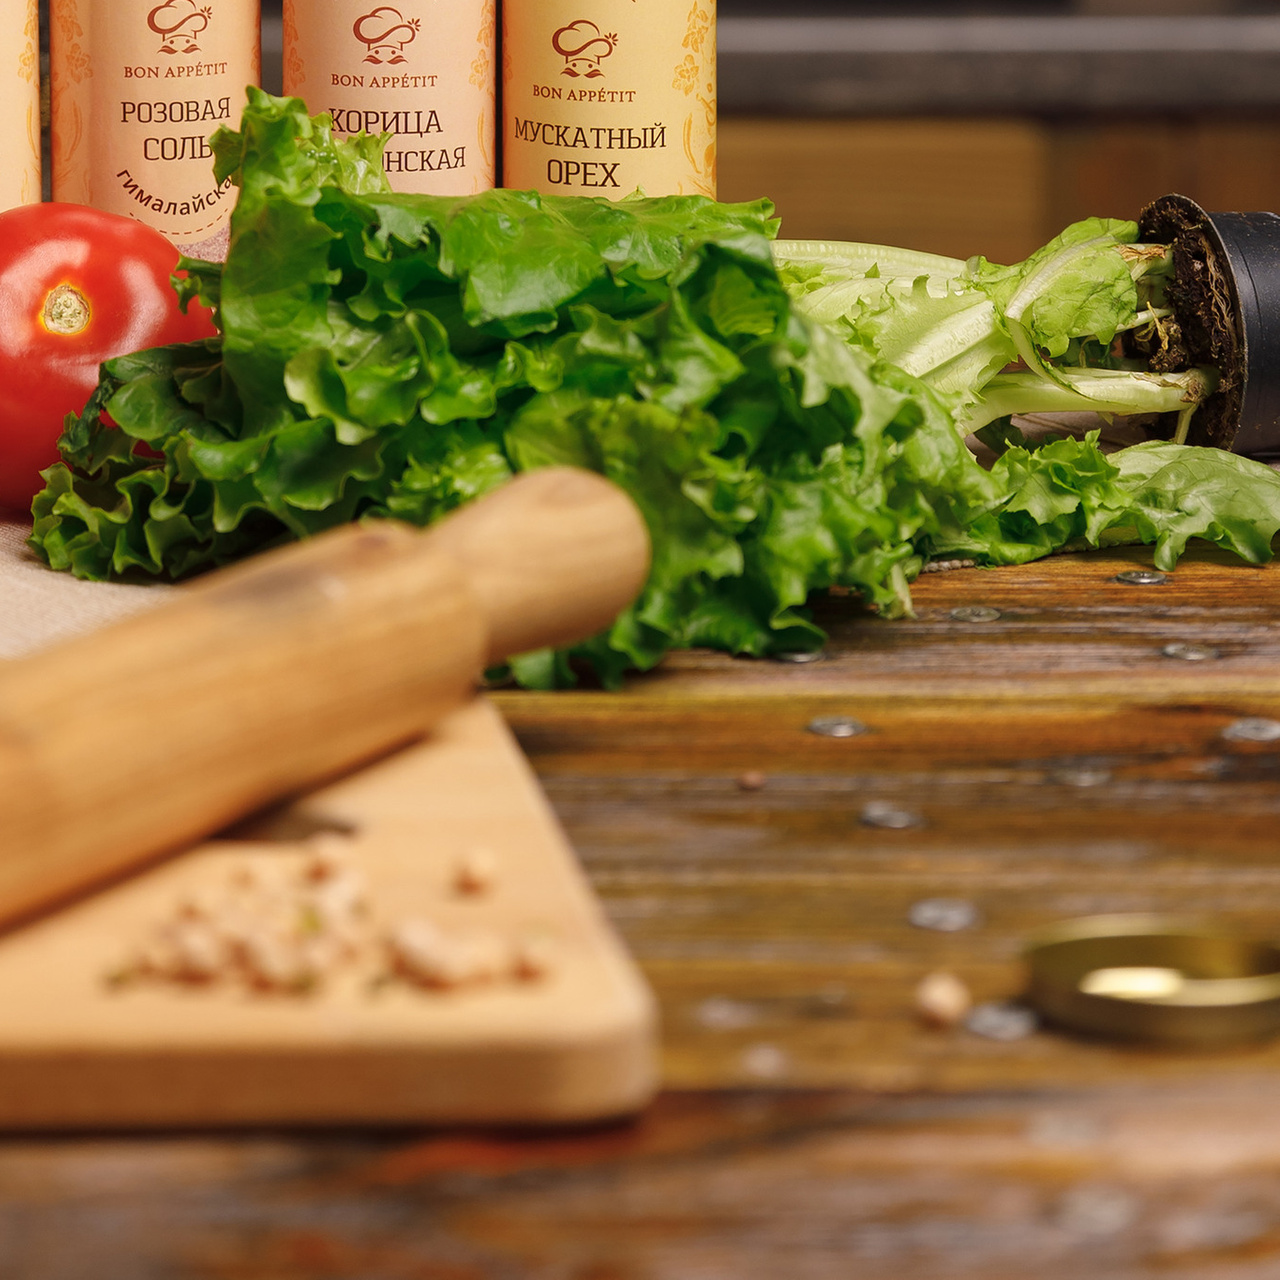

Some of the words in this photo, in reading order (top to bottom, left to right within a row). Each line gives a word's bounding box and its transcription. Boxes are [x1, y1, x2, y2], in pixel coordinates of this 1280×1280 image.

[123, 66, 160, 79] BON
[164, 61, 228, 79] APPÉTIT
[331, 73, 365, 87] BON
[369, 72, 438, 88] APPÉTIT
[532, 84, 562, 100] BON
[566, 86, 637, 103] APPÉTIT
[120, 96, 231, 124] РОЗОВАЯ
[328, 107, 444, 138] КОРИЦА
[514, 116, 667, 150] МУСКАТНЫЙ
[143, 135, 213, 161] СОЛЬ
[382, 145, 467, 173] НСКАЯ
[546, 158, 621, 188] ОРЕХ
[116, 169, 232, 216] гималайска
